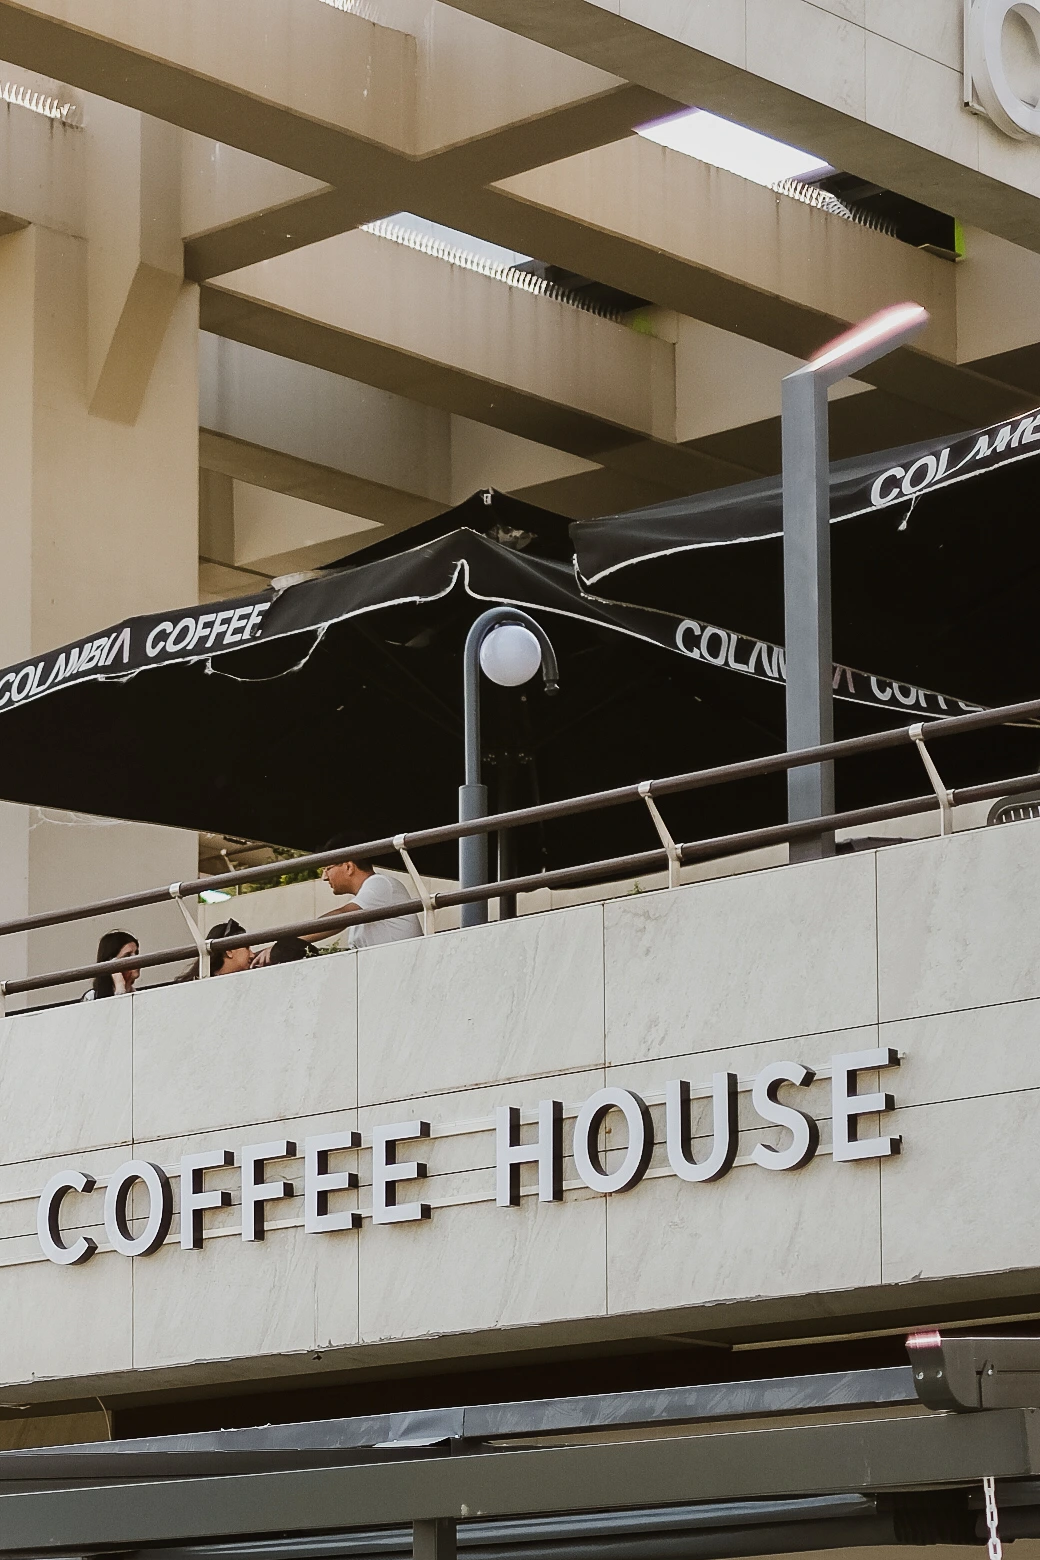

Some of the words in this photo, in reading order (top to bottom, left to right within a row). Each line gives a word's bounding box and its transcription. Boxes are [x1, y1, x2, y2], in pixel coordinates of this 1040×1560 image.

[146, 602, 272, 658] COFFEE
[36, 1120, 432, 1265] COFFEE
[495, 1047, 903, 1208] HOUSE
